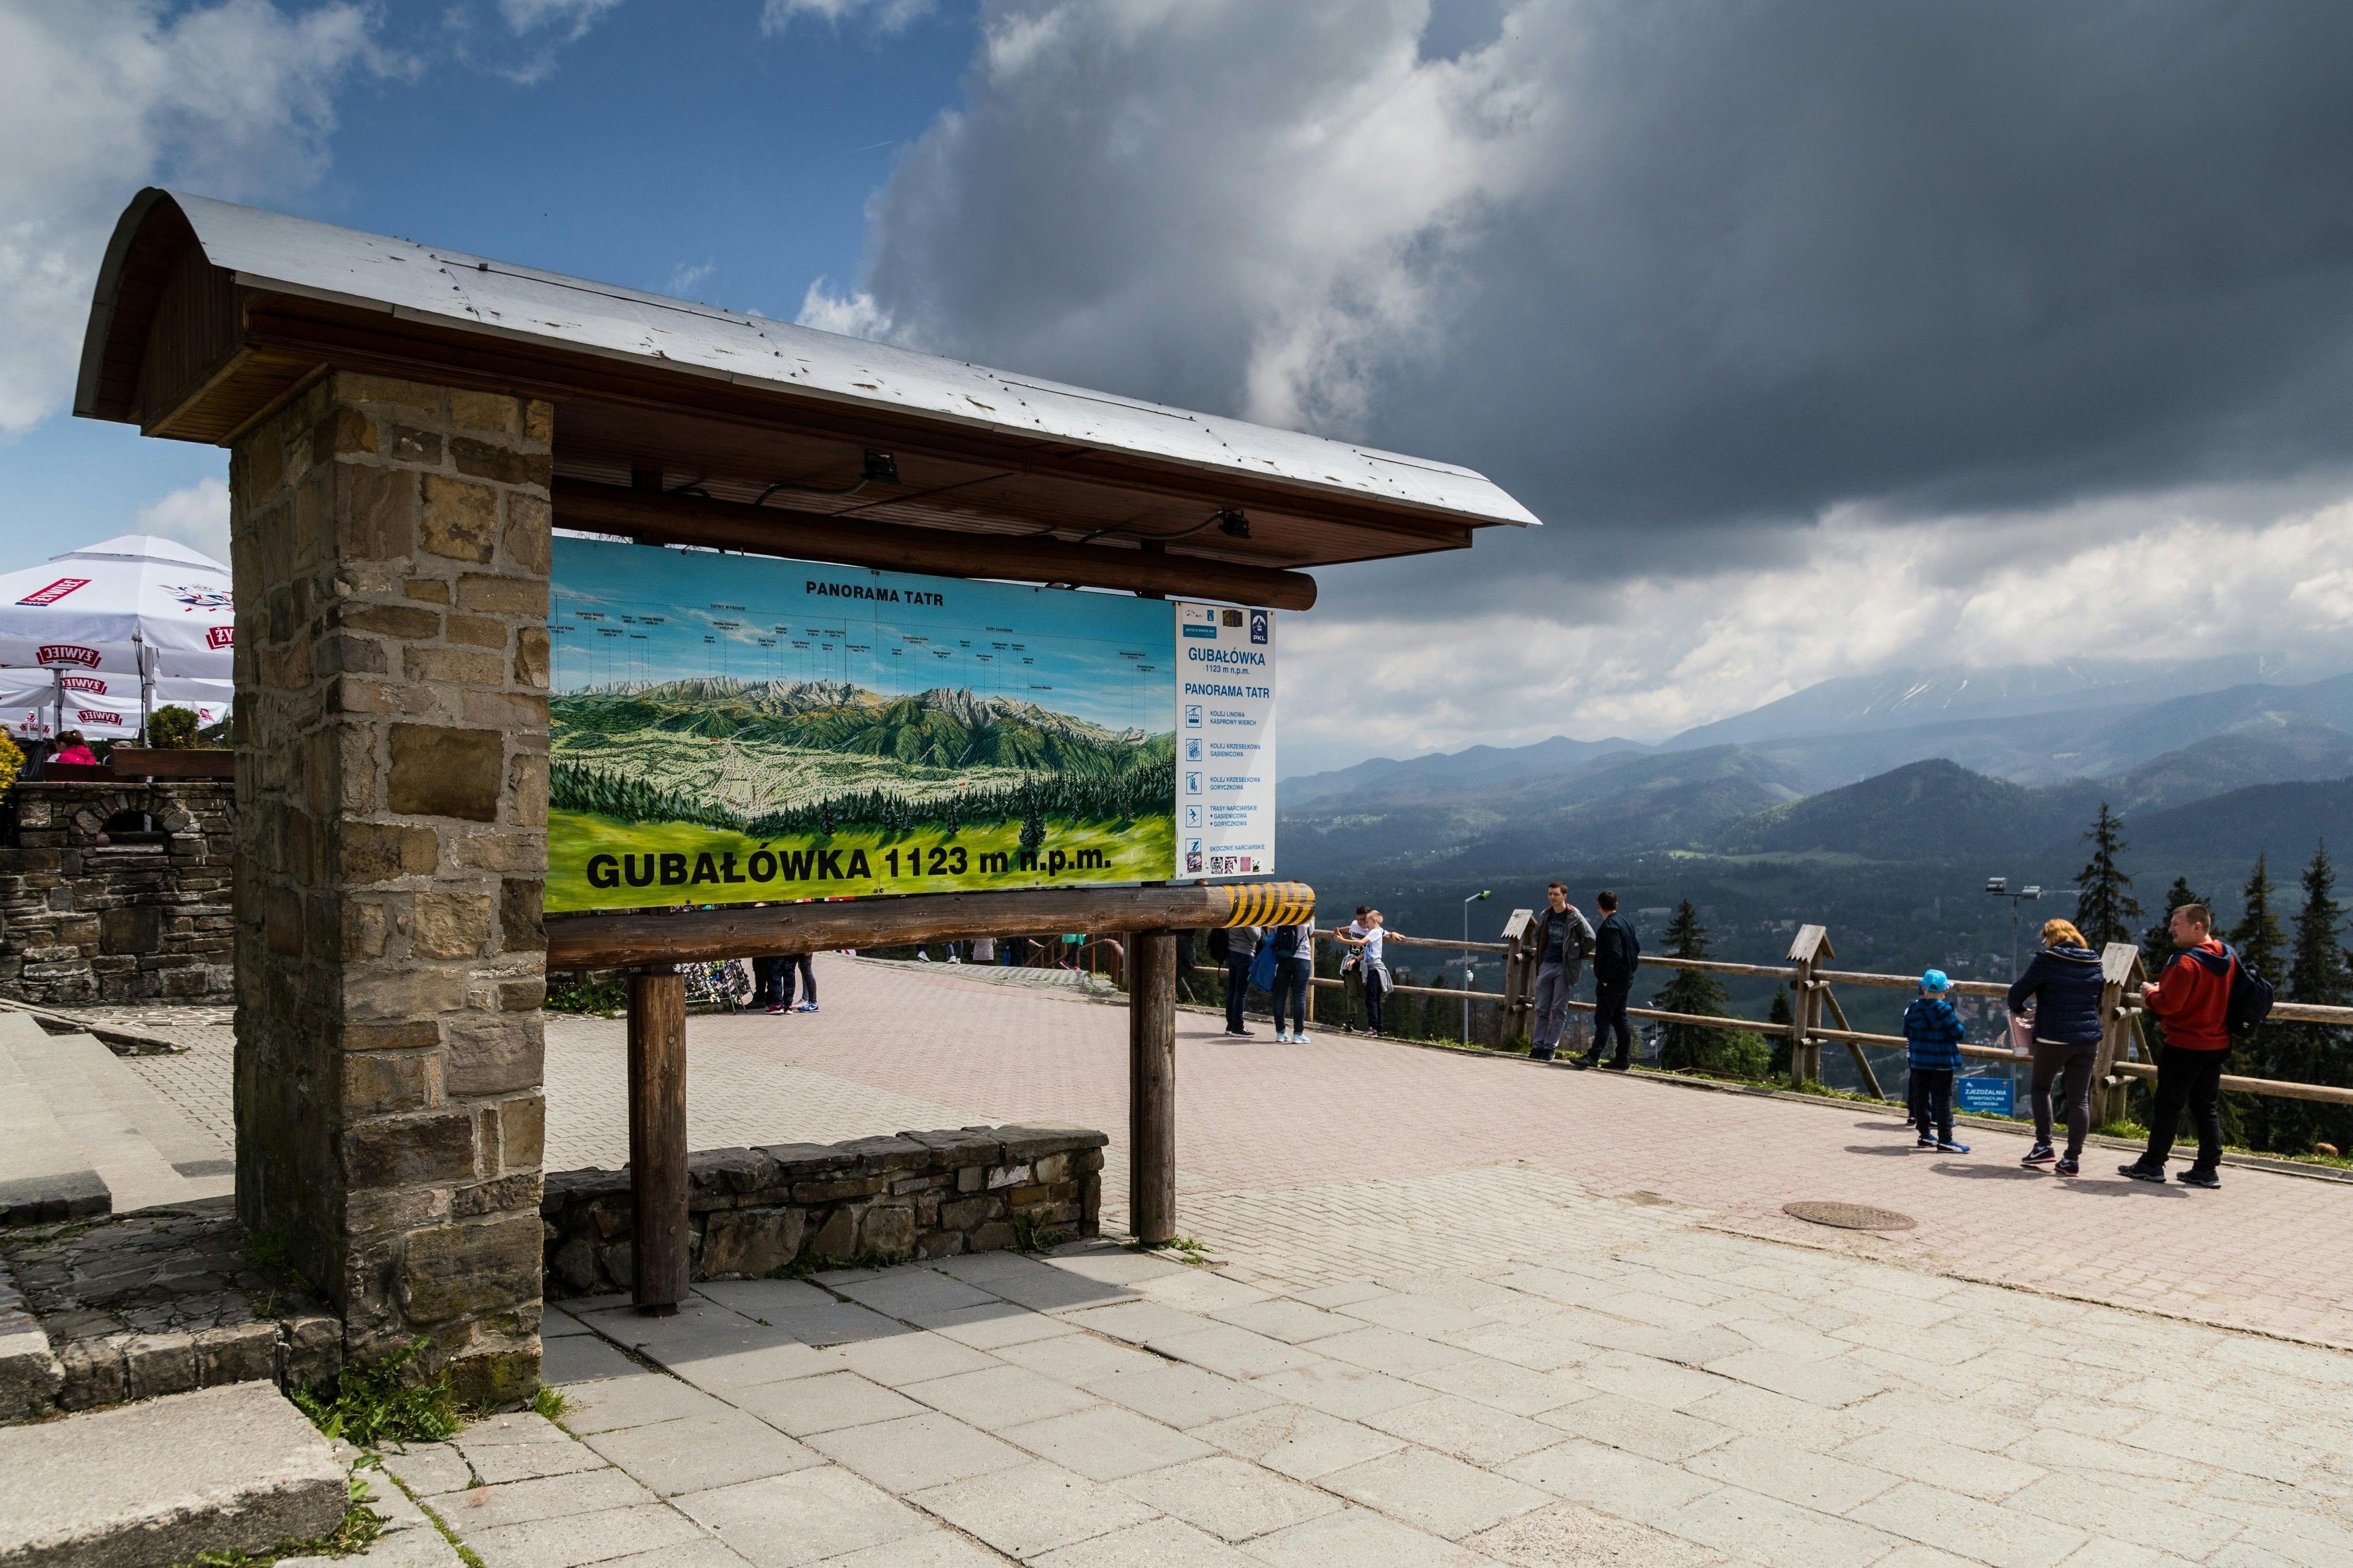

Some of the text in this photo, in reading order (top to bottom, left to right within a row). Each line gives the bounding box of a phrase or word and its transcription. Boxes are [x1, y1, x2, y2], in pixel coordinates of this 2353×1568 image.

[27, 580, 84, 601] ŻYWIEC
[805, 581, 943, 607] PANORAMA TATR
[1188, 647, 1265, 666] GUBAŁÓWKA
[1205, 665, 1221, 673] 1123
[1230, 667, 1250, 675] n.p.m.
[1185, 683, 1270, 698] PANORAMA TATR
[586, 843, 1111, 889] GUBAŁÓWKA 1123 m n.p.m.
